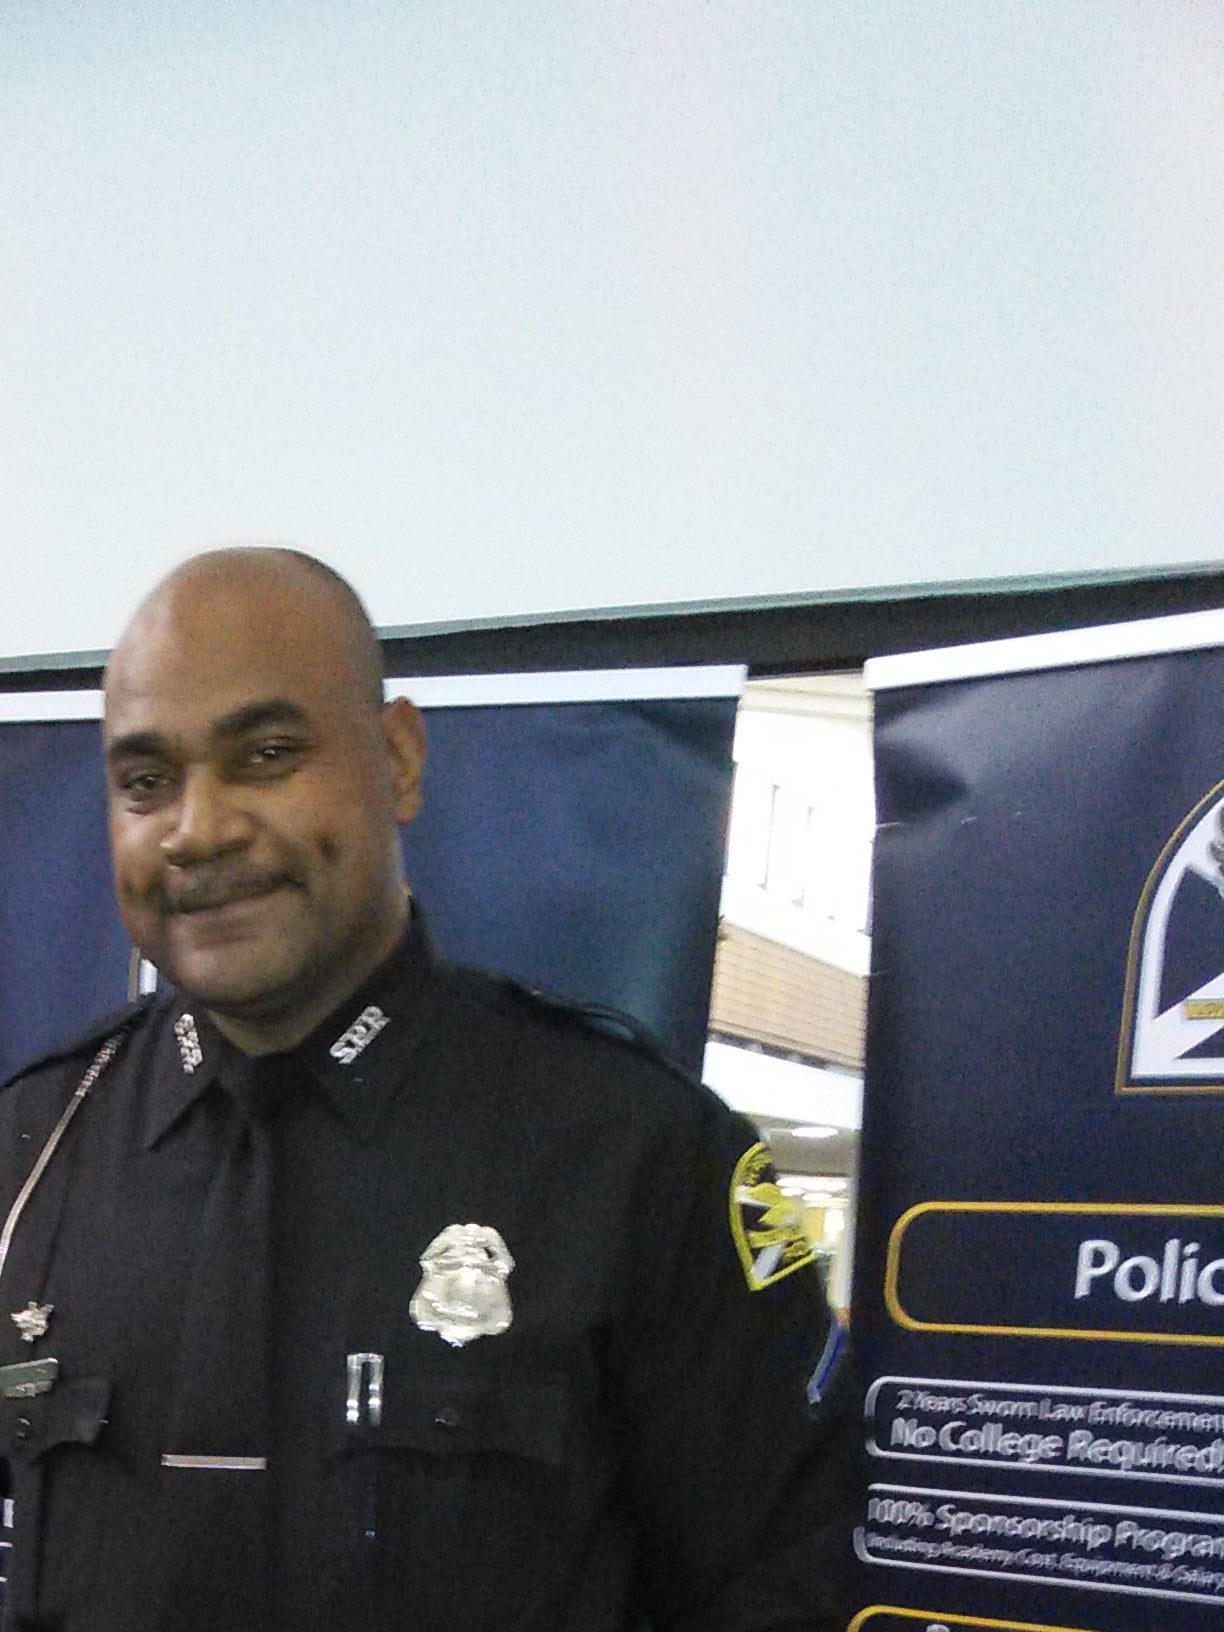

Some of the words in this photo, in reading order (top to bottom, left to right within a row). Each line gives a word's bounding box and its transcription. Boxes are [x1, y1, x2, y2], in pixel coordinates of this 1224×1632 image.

[1074, 1238, 1224, 1307] Polic
[1038, 1398, 1088, 1421] Law
[890, 1417, 936, 1447] No
[939, 1421, 1063, 1463] College
[867, 1497, 935, 1527] 100%
[935, 1504, 1112, 1550] Sponsorship
